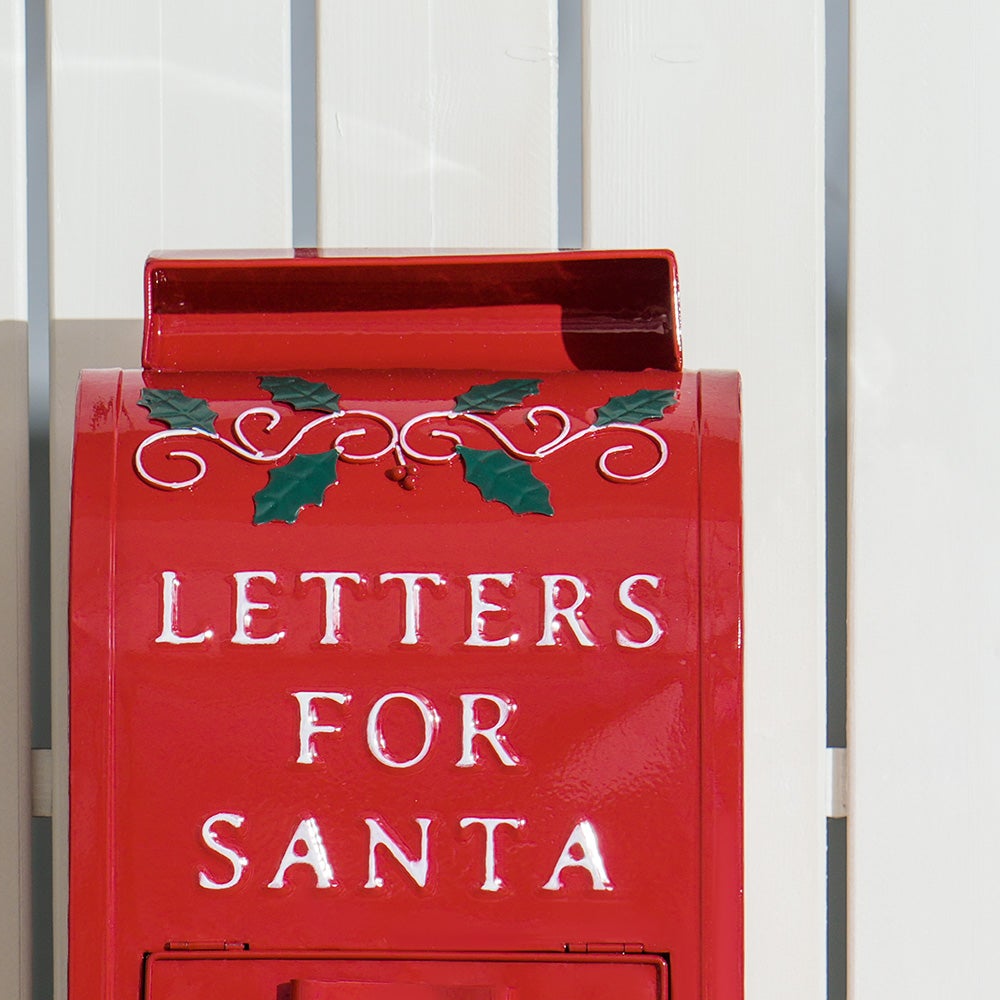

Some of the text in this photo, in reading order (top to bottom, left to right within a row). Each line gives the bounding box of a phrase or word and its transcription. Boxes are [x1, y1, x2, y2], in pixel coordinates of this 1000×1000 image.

[154, 571, 666, 649] LETTERS
[290, 691, 521, 769] FOR
[198, 812, 614, 892] SANTA
